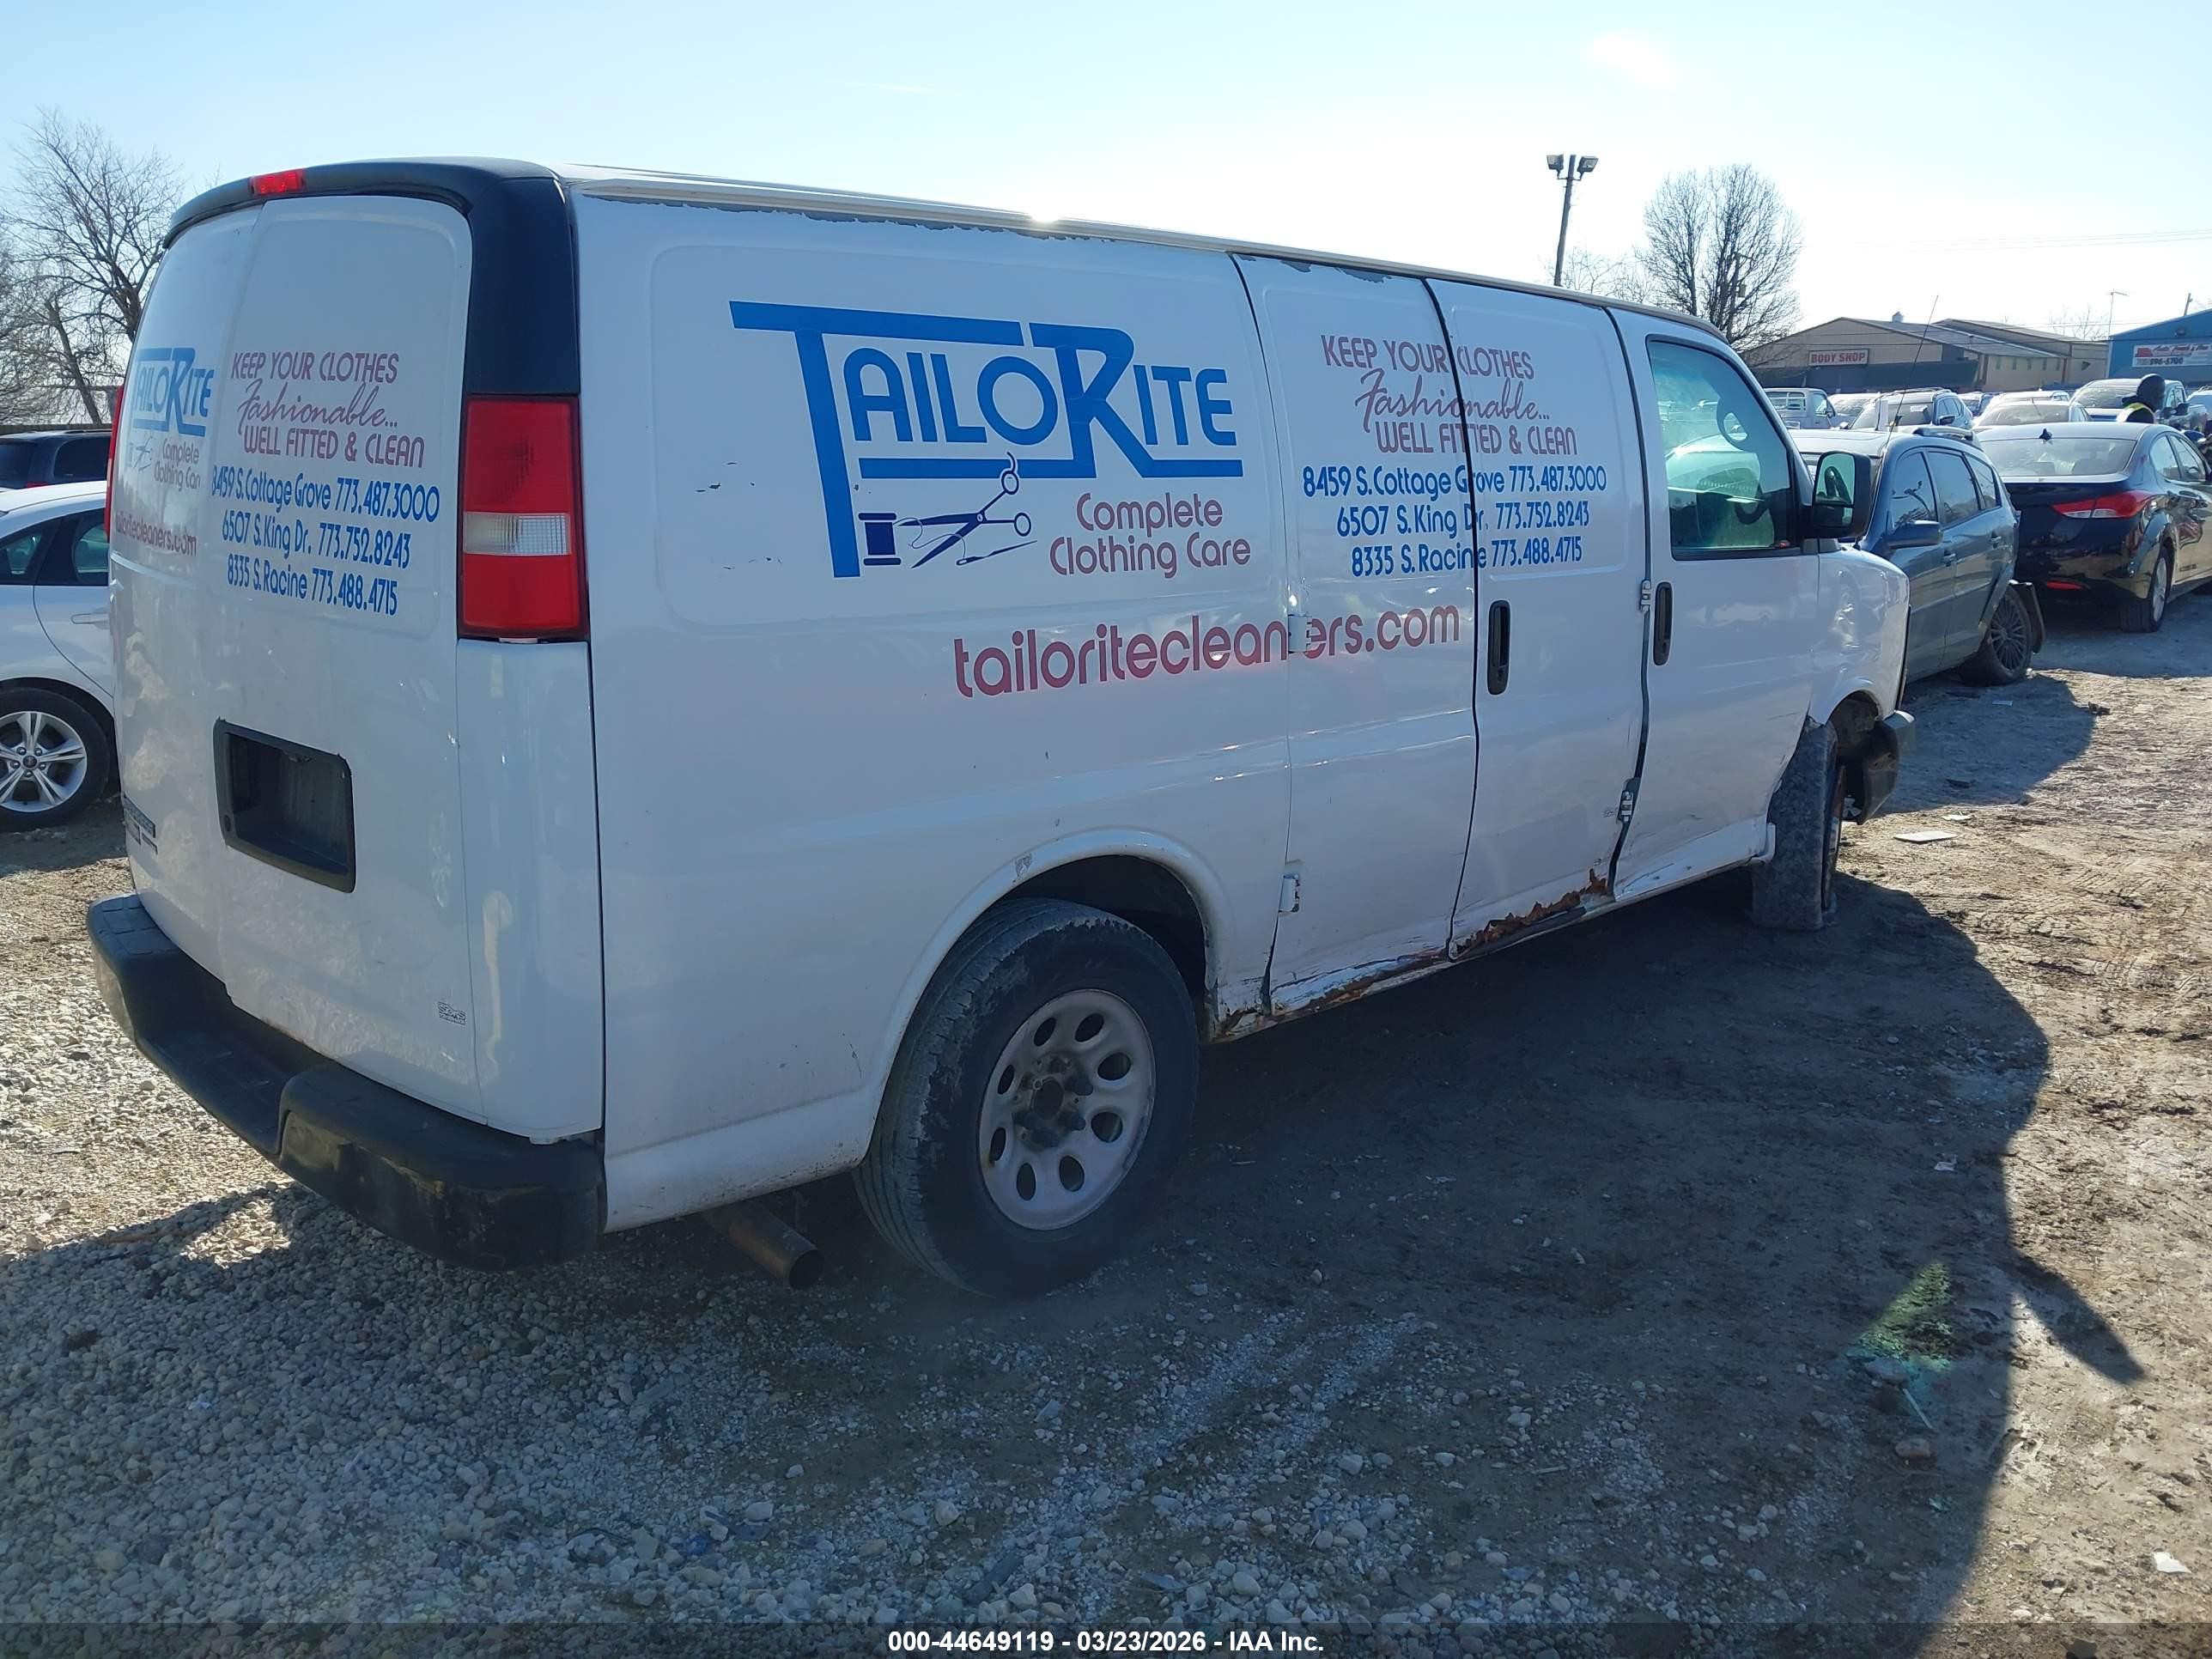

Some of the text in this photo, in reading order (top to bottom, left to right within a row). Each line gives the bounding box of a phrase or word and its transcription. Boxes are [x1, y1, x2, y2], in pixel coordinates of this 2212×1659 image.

[230, 351, 399, 384] KEEP YOUR CLOTHES
[1321, 334, 1534, 380] KEEP YOUR CLOTHES
[1811, 352, 1866, 363] BODY SHOP
[162, 438, 199, 466] Complete
[243, 425, 425, 468] WELL FITTED & CLEAN
[1375, 421, 1434, 453] WELL
[1509, 424, 1522, 454] &
[1527, 425, 1578, 455] CLEAN
[211, 465, 235, 498] 8459
[295, 472, 331, 510] Grove
[335, 477, 441, 523] 773.487.3000
[1303, 465, 1352, 497] 8459
[1455, 465, 1505, 494] Gove
[1509, 465, 1607, 493] 773.487.3000
[1076, 492, 1223, 537] Complete
[1336, 505, 1389, 537] 6507
[1496, 501, 1589, 530] 773.752.8243
[222, 509, 252, 544] 6507
[295, 519, 312, 555] Dr.
[318, 522, 411, 569] 773.752.8243
[1049, 532, 1251, 580] Clothing Care
[1352, 545, 1395, 577] 8335
[1491, 535, 1583, 568] 773.488.4715
[227, 553, 250, 587] 8335
[312, 567, 398, 617] 773.488.4715
[954, 605, 1460, 698] tailoritecleaners.com
